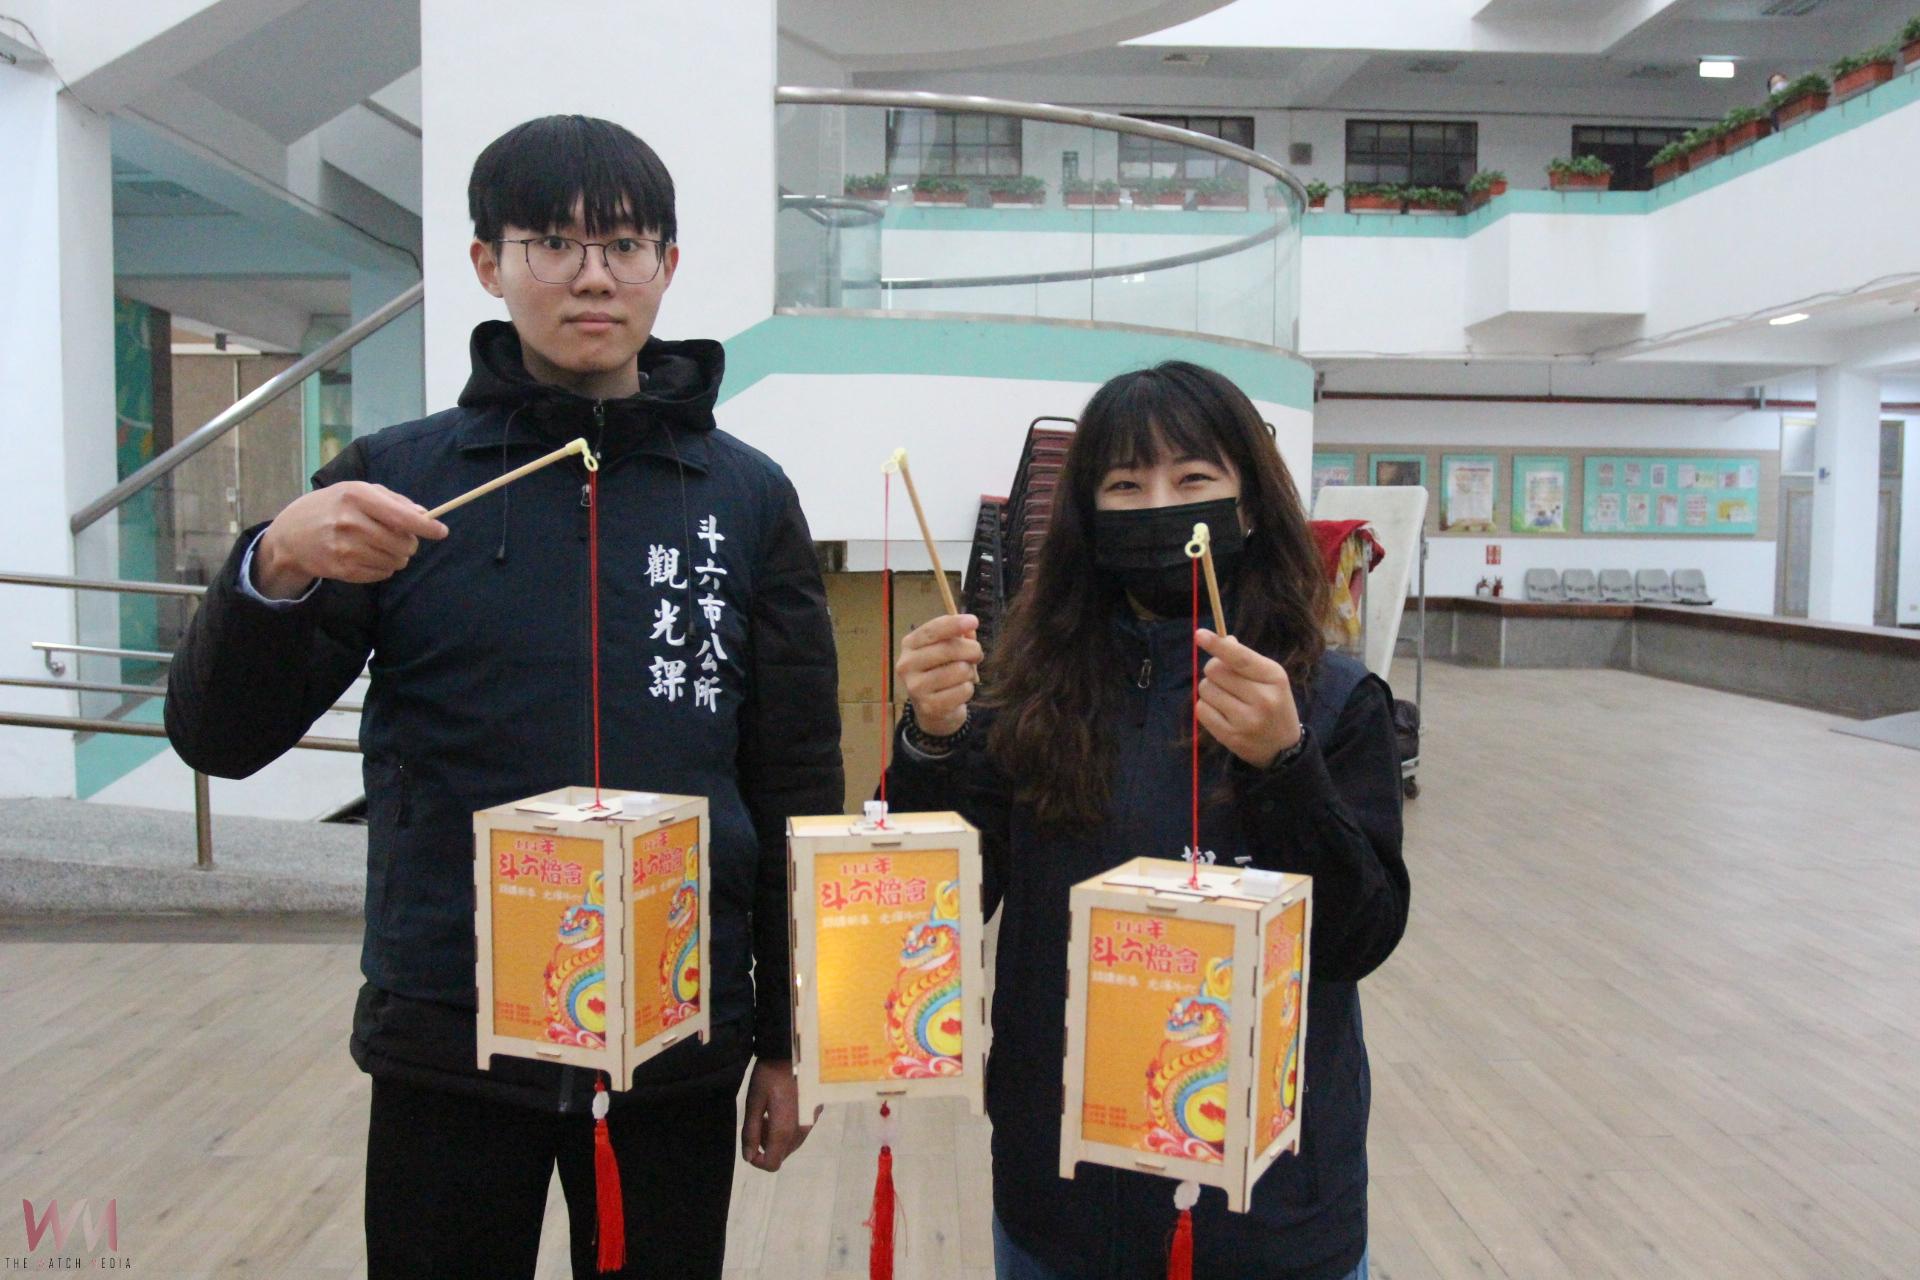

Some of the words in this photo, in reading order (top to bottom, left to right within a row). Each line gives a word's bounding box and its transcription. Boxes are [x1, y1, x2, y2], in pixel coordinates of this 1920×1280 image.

[644, 544, 688, 702] 觀光課
[694, 514, 728, 713] 斗六市公所
[498, 853, 583, 886] 斗六燈會
[820, 877, 928, 910] 斗六燈會
[1092, 935, 1200, 975] 斗六燈會
